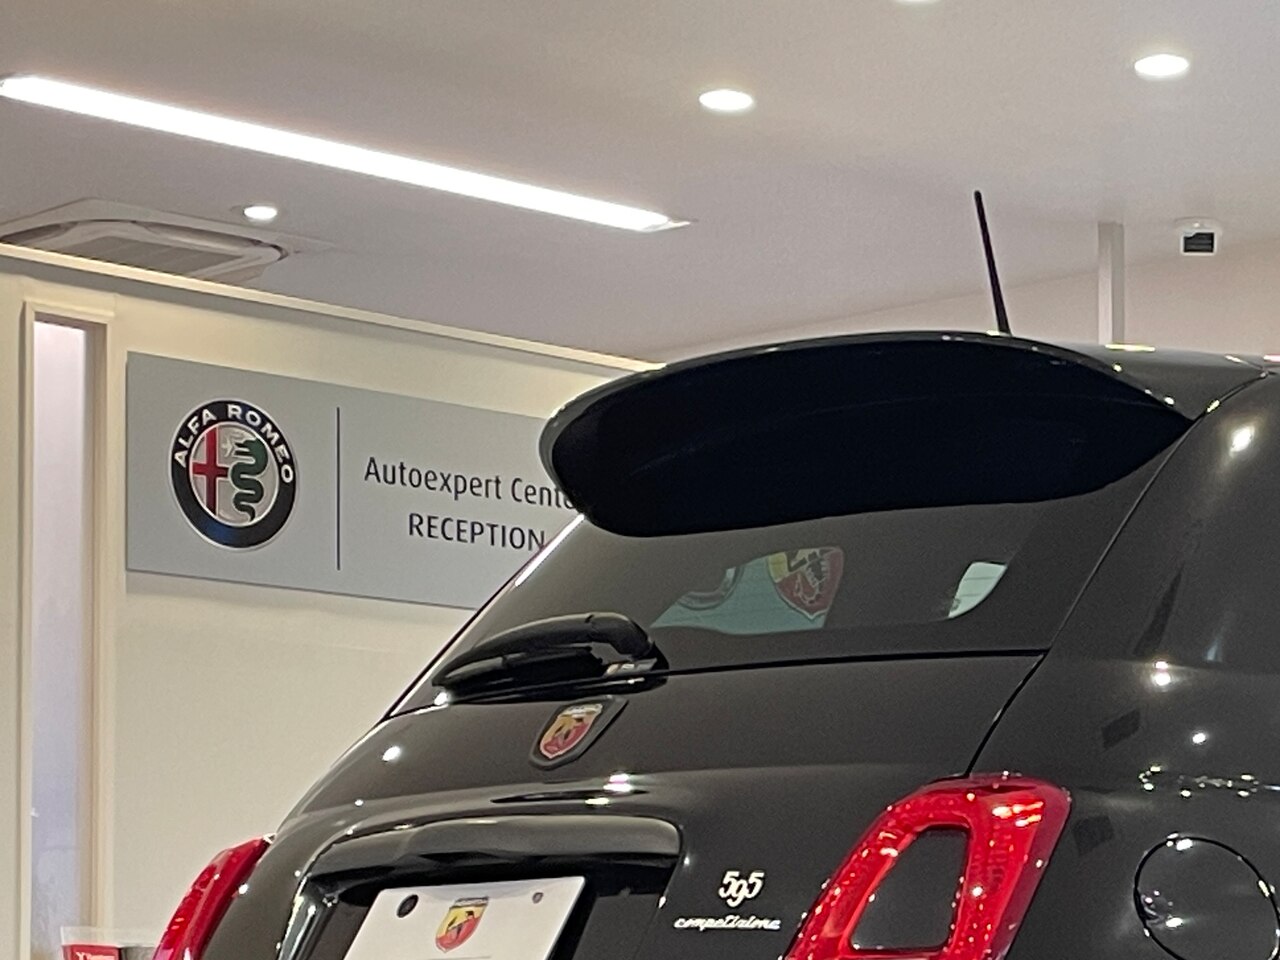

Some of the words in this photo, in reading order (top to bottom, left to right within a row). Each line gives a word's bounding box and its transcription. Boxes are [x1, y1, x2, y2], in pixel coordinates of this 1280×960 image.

[174, 408, 217, 468] ALFA
[226, 403, 294, 483] ROMEO
[364, 456, 502, 501] Autoexpert
[408, 512, 546, 551] RECEPTION
[718, 870, 765, 908] 595
